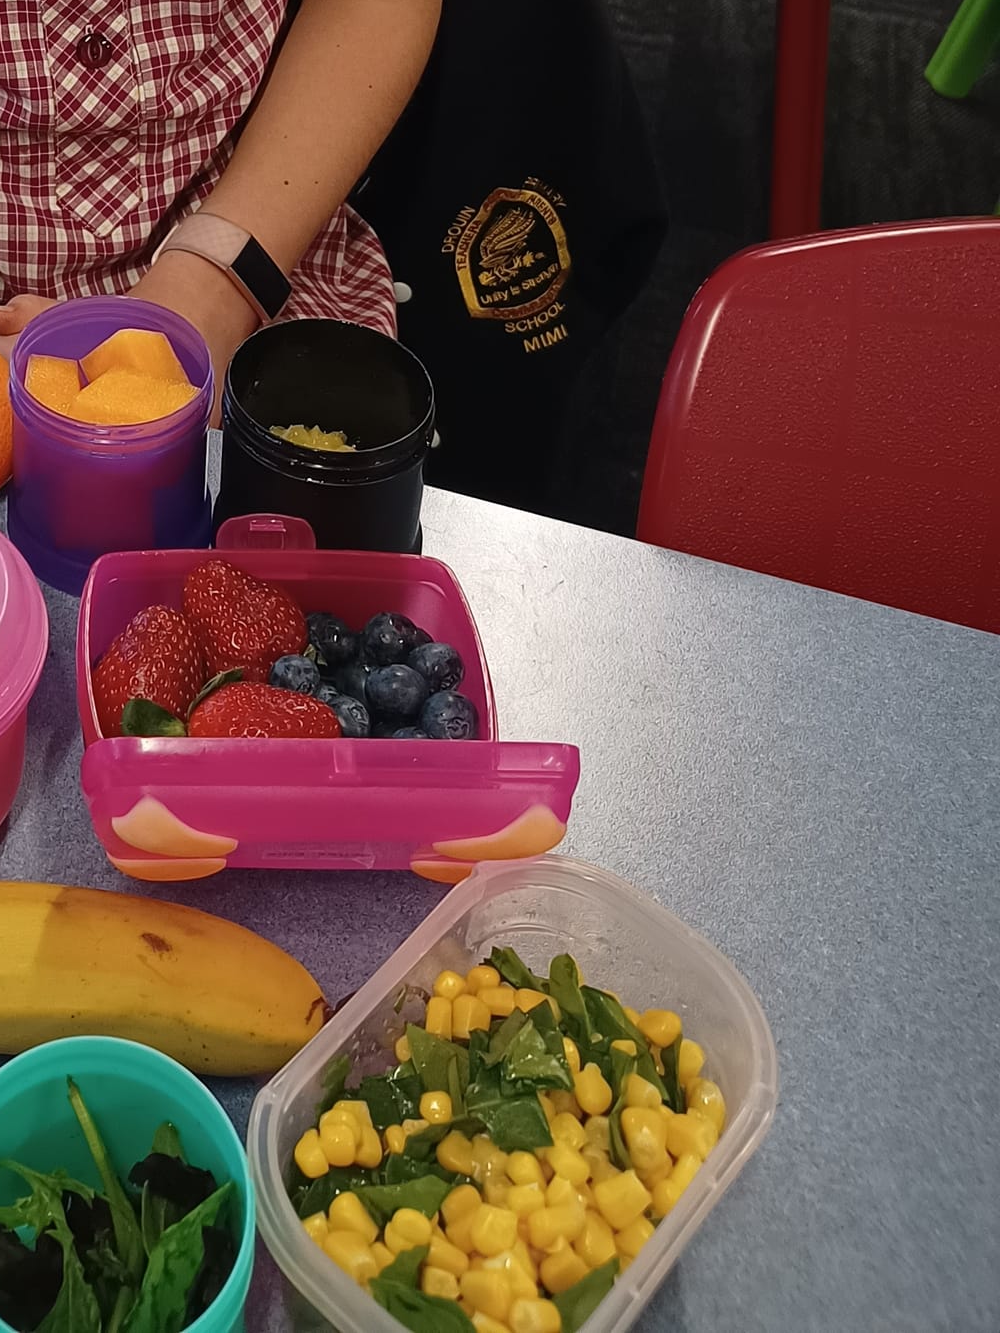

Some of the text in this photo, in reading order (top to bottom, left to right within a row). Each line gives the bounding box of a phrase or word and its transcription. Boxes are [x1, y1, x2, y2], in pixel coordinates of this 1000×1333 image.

[441, 205, 477, 254] DROUIN
[479, 287, 508, 305] Unity
[504, 300, 567, 333] SCHOOL
[522, 323, 569, 354] MIMI
